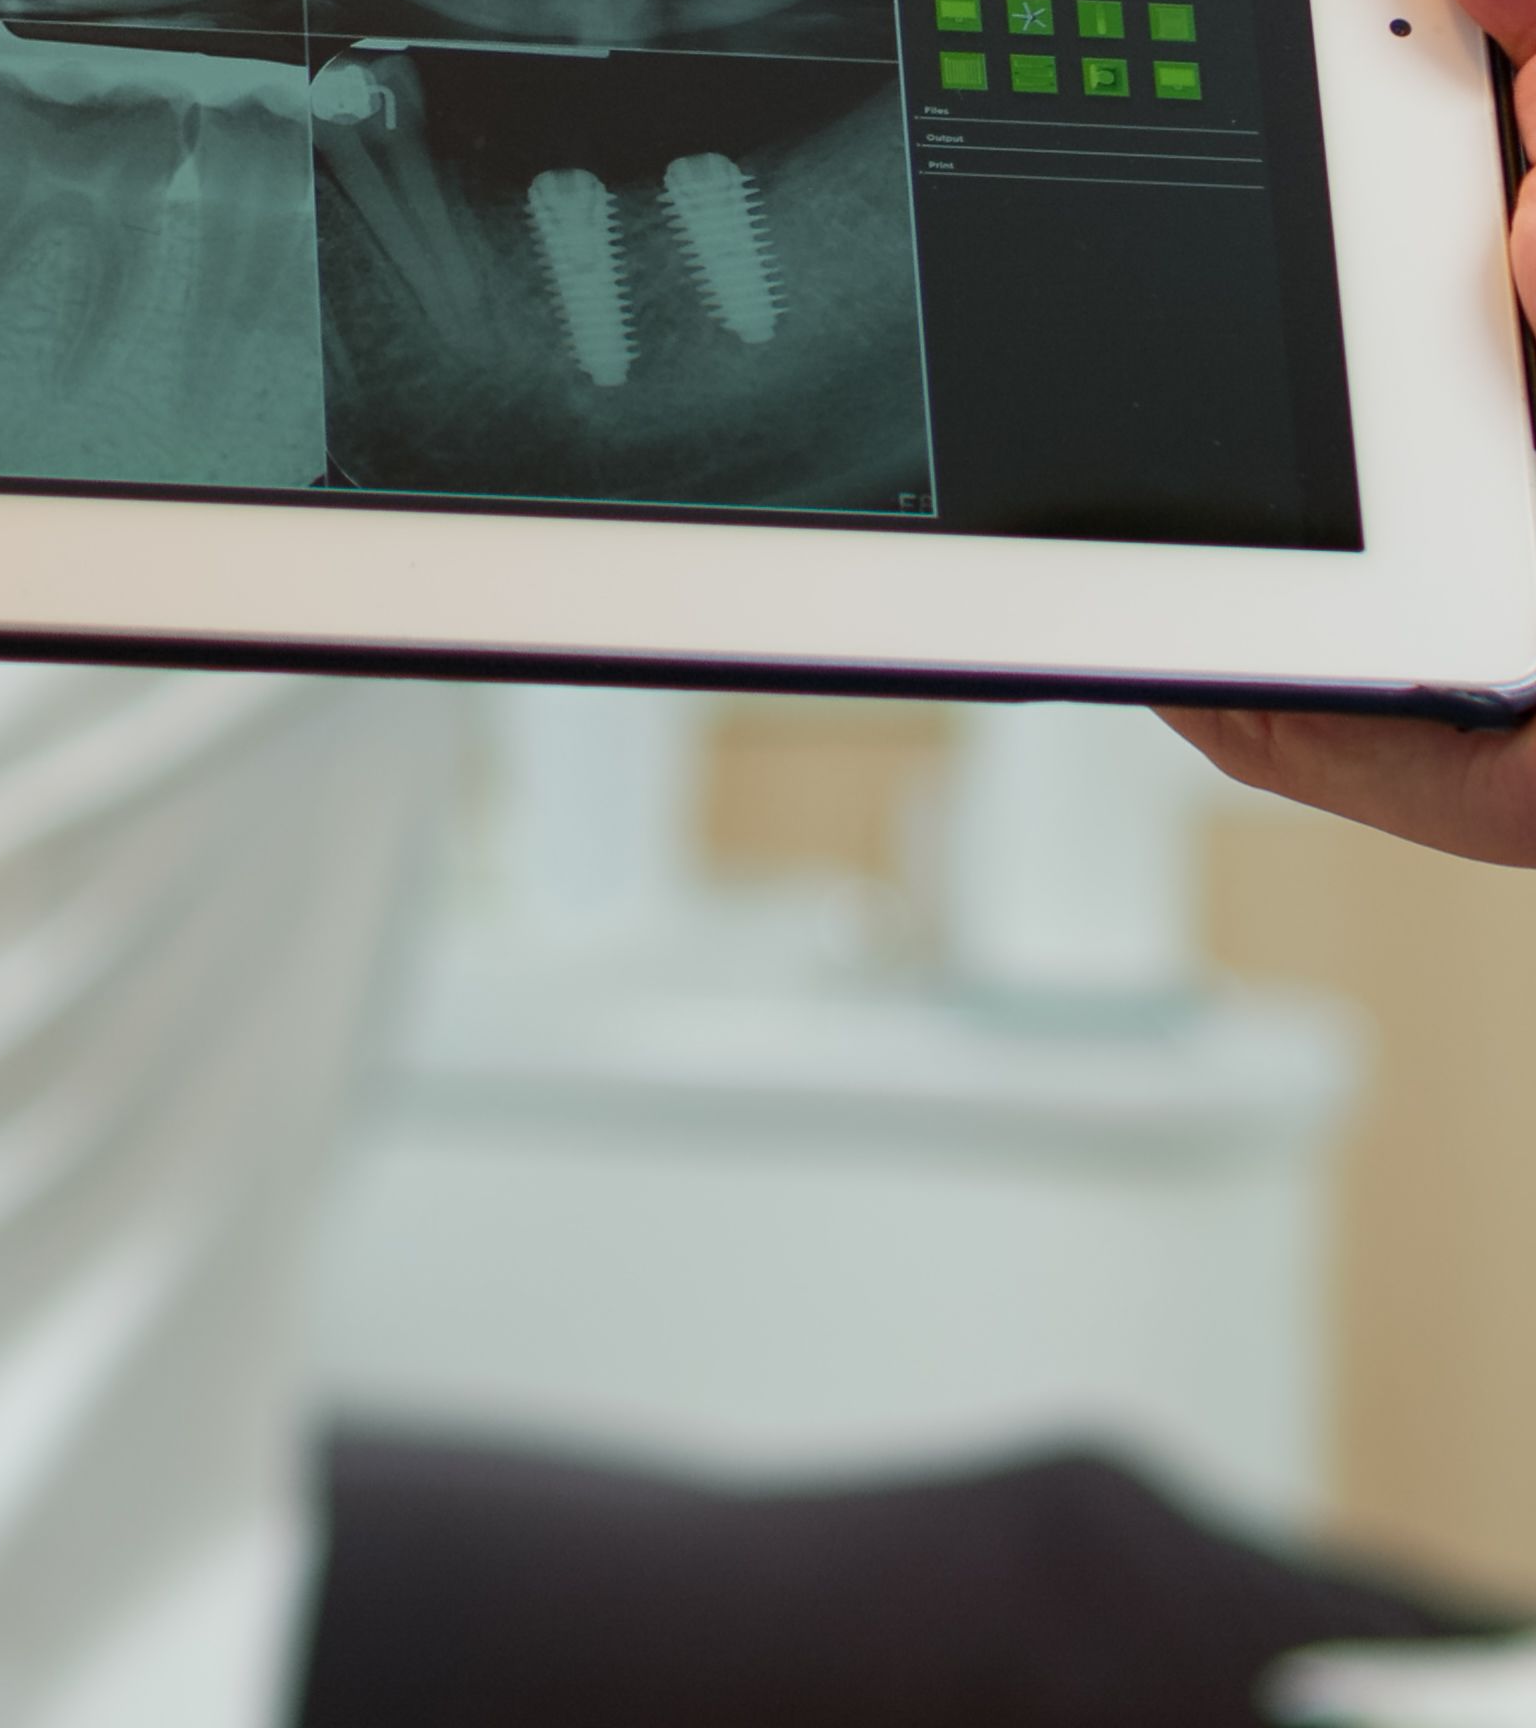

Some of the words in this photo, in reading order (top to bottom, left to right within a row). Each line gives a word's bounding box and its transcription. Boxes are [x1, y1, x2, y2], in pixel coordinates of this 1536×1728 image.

[924, 106, 949, 115] Files
[926, 133, 964, 143] Output
[928, 160, 954, 169] Print
